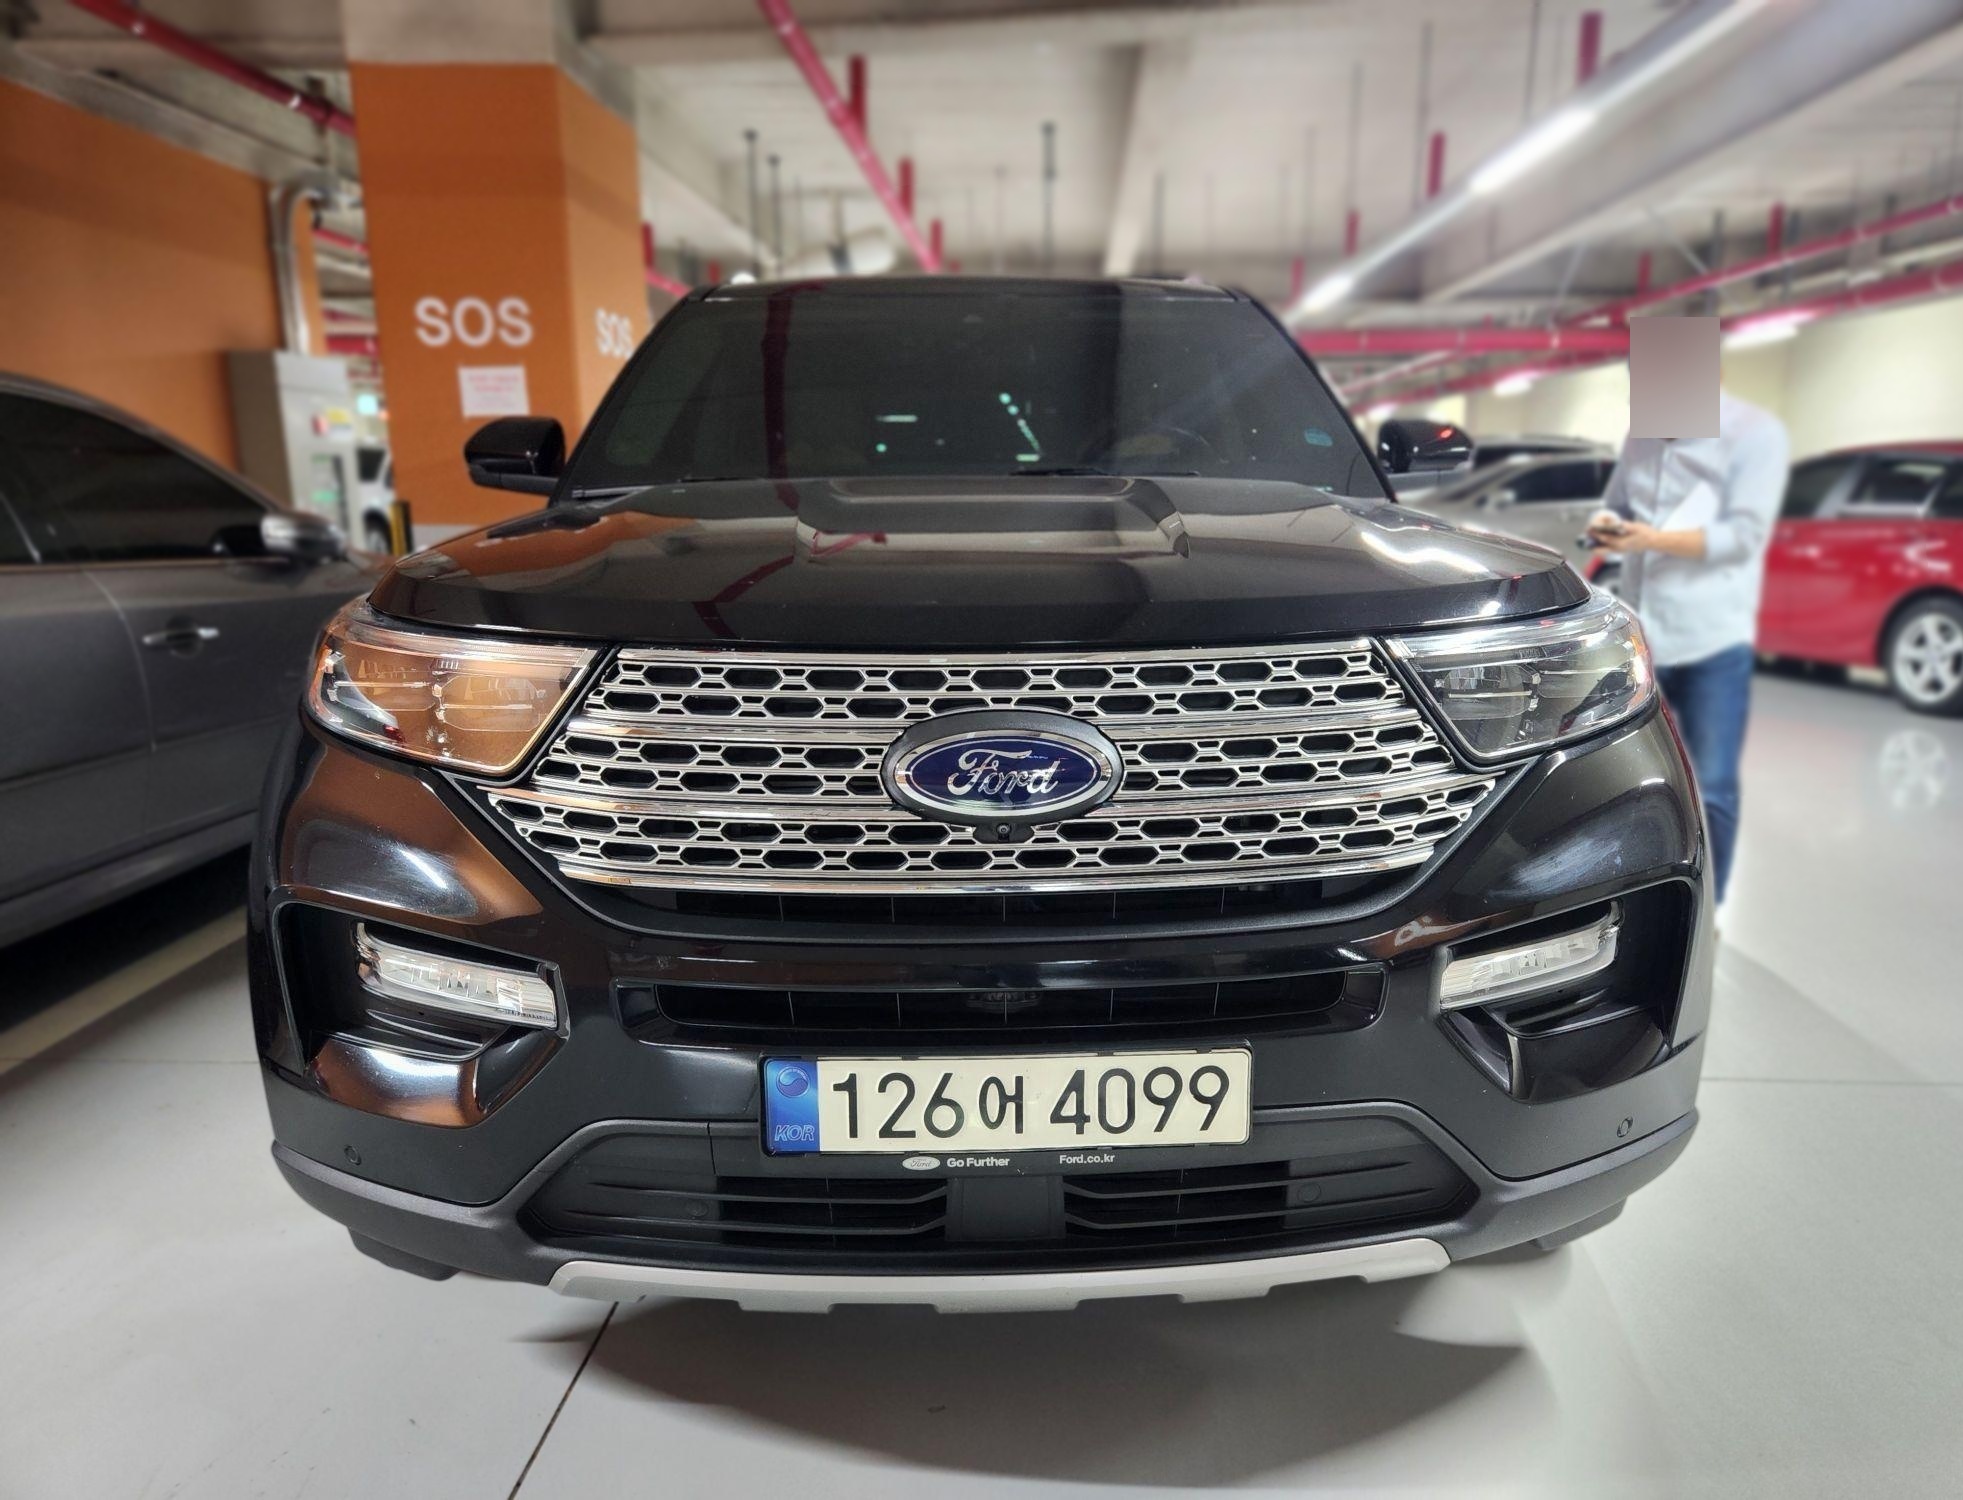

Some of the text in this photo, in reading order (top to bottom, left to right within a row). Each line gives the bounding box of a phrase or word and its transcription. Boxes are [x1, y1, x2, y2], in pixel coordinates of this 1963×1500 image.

[414, 296, 534, 348] SOS
[595, 308, 634, 360] SOS
[947, 748, 1060, 796] Ford
[1049, 1065, 1230, 1136] 4099
[774, 1124, 815, 1142] KOR
[946, 1157, 1010, 1168] Go Further
[1059, 1153, 1116, 1165] Ford.co.kr
